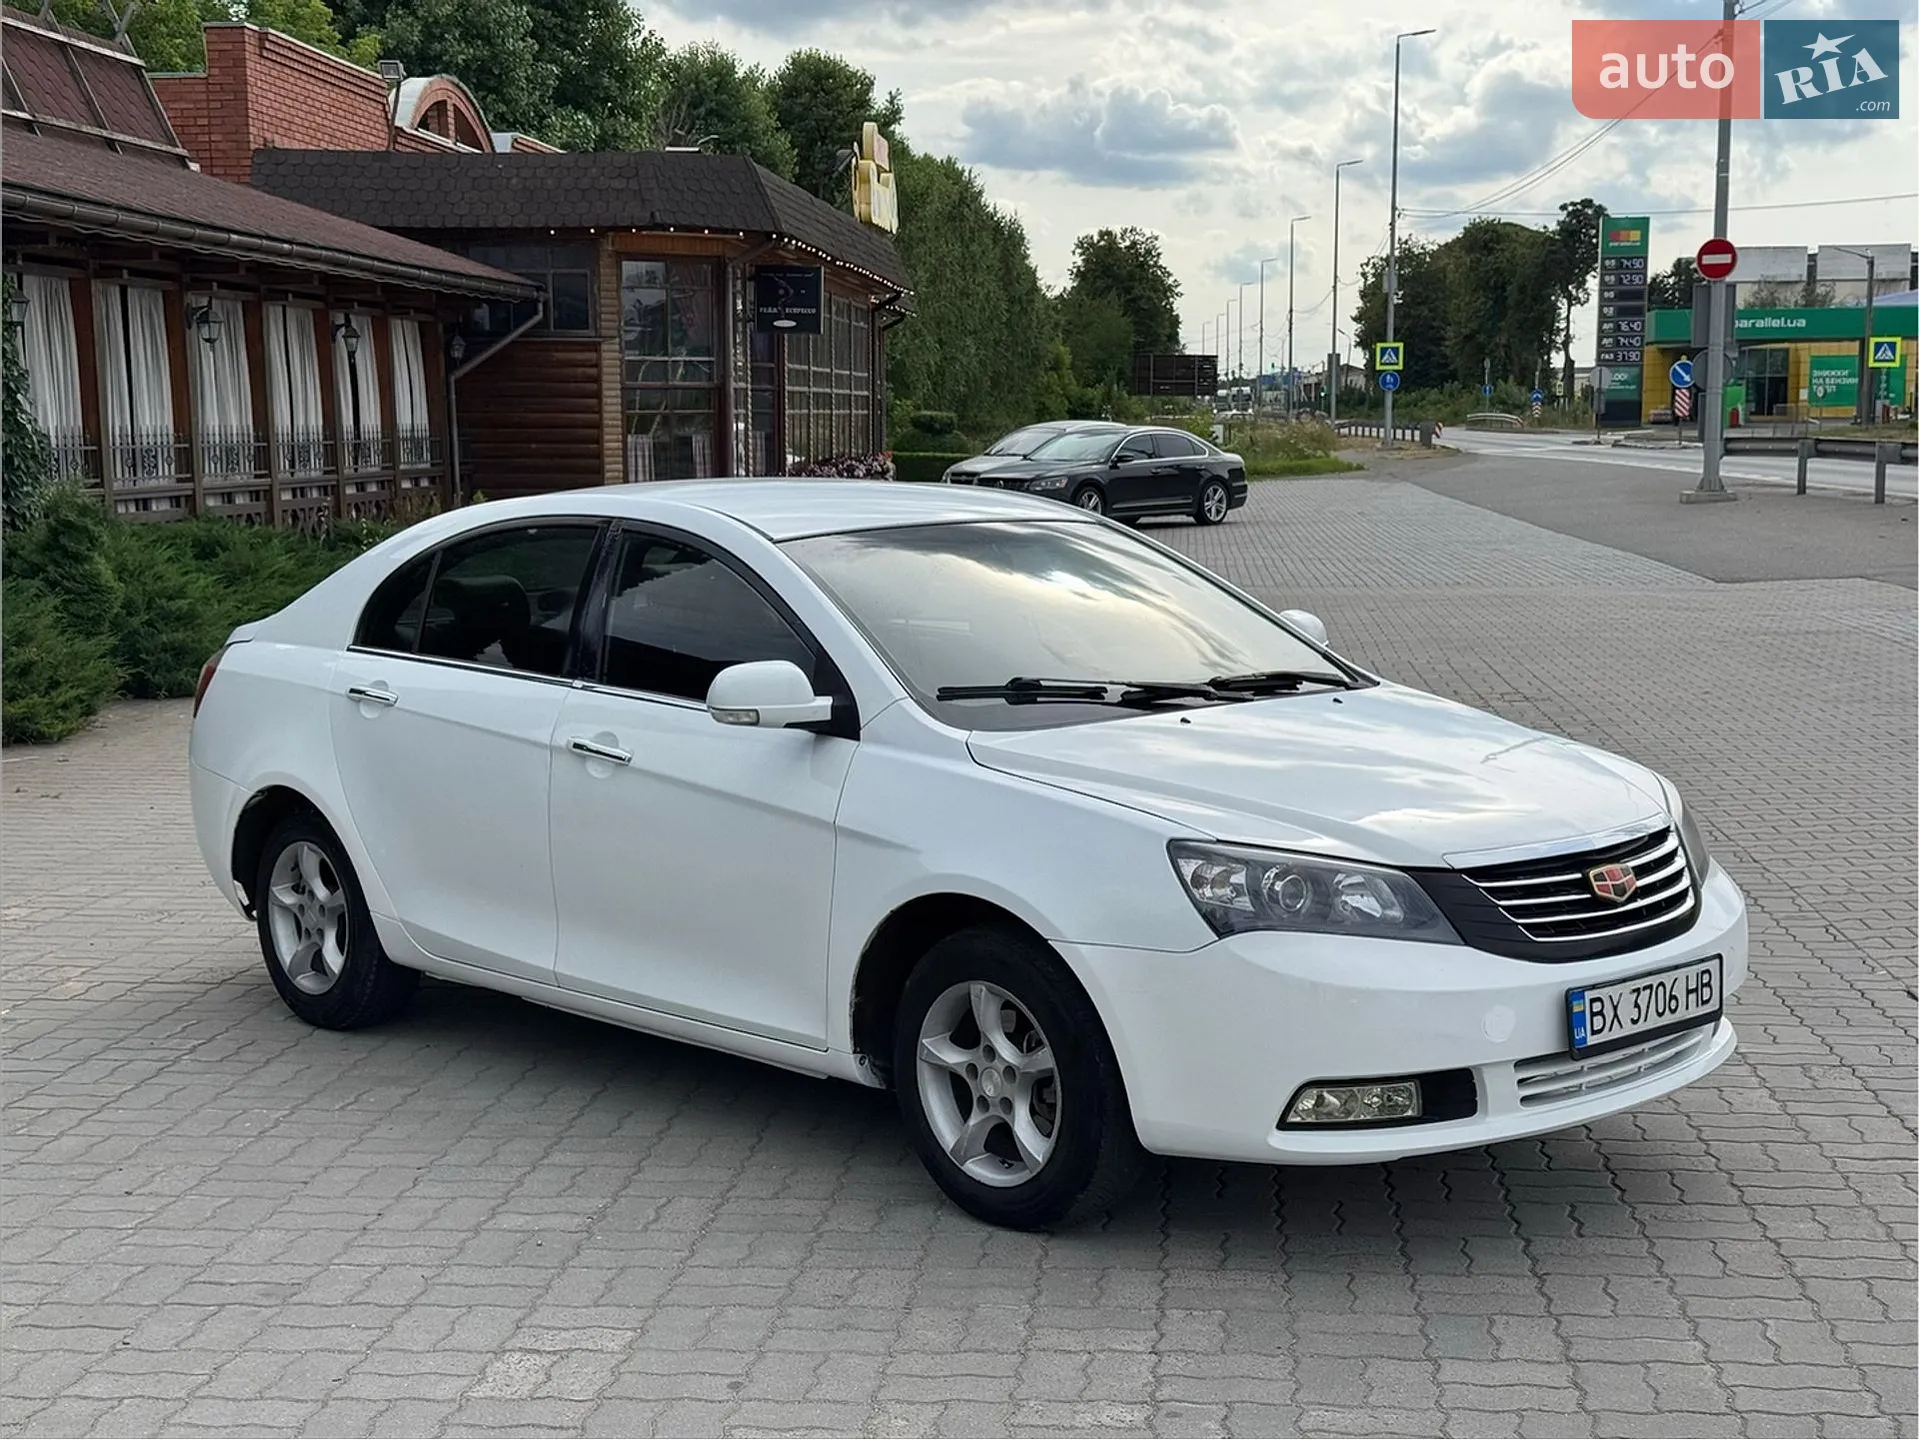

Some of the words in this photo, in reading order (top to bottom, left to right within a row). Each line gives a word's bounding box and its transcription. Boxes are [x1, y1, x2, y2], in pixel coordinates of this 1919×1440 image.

[1589, 991, 1624, 1036] BX
[1629, 977, 1679, 1025] 3706
[1685, 968, 1714, 1011] HB
[1574, 1027, 1586, 1040] UA
